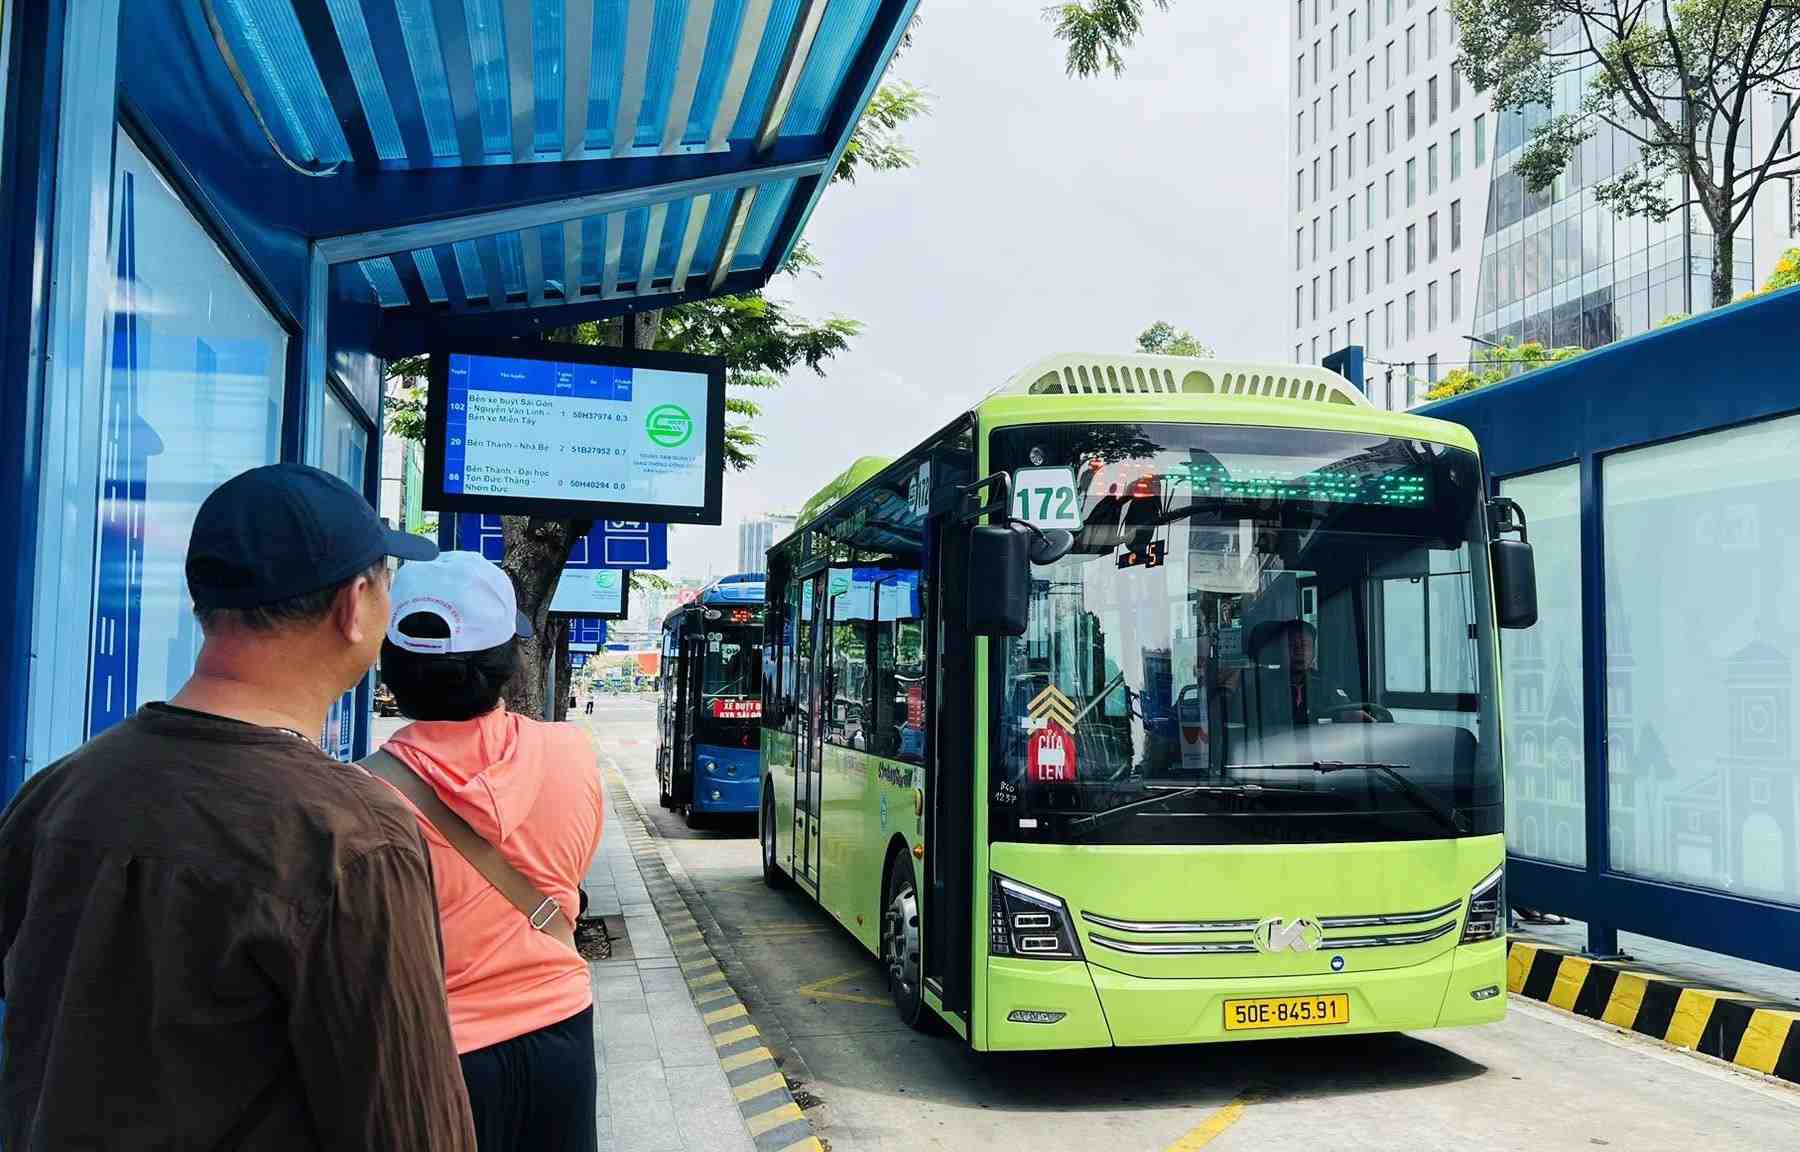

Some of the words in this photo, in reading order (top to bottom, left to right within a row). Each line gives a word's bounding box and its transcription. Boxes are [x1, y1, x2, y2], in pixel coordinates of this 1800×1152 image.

[450, 402, 465, 411] 102
[450, 437, 462, 446] 20
[1016, 486, 1075, 521] 172
[1235, 1000, 1337, 1024] 50E-845.91
